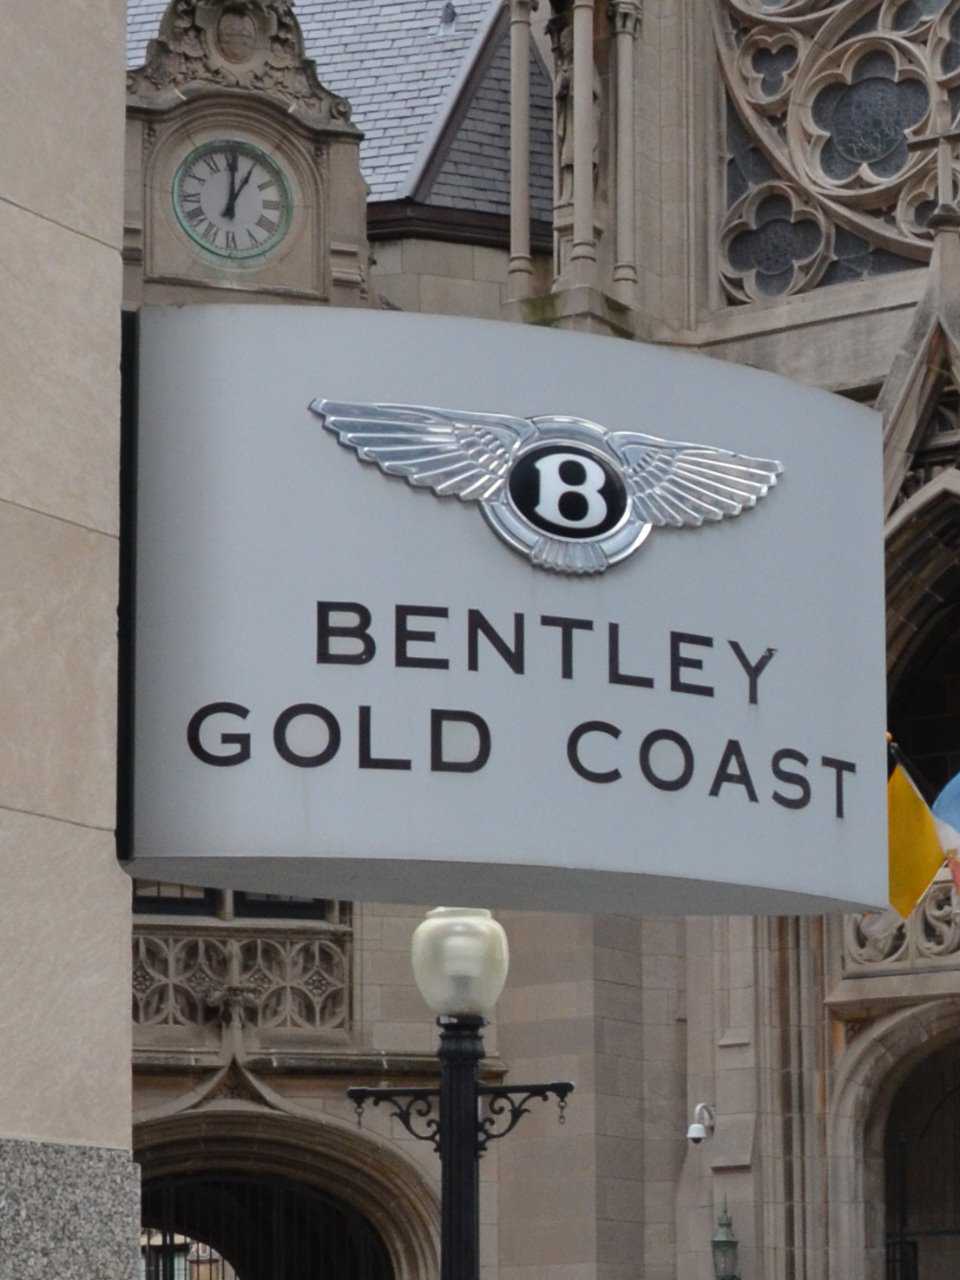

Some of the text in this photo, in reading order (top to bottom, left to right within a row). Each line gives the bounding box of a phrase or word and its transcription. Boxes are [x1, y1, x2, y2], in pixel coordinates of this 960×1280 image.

[315, 600, 778, 705] BENTLEY
[186, 701, 857, 819] GOLD COAST
